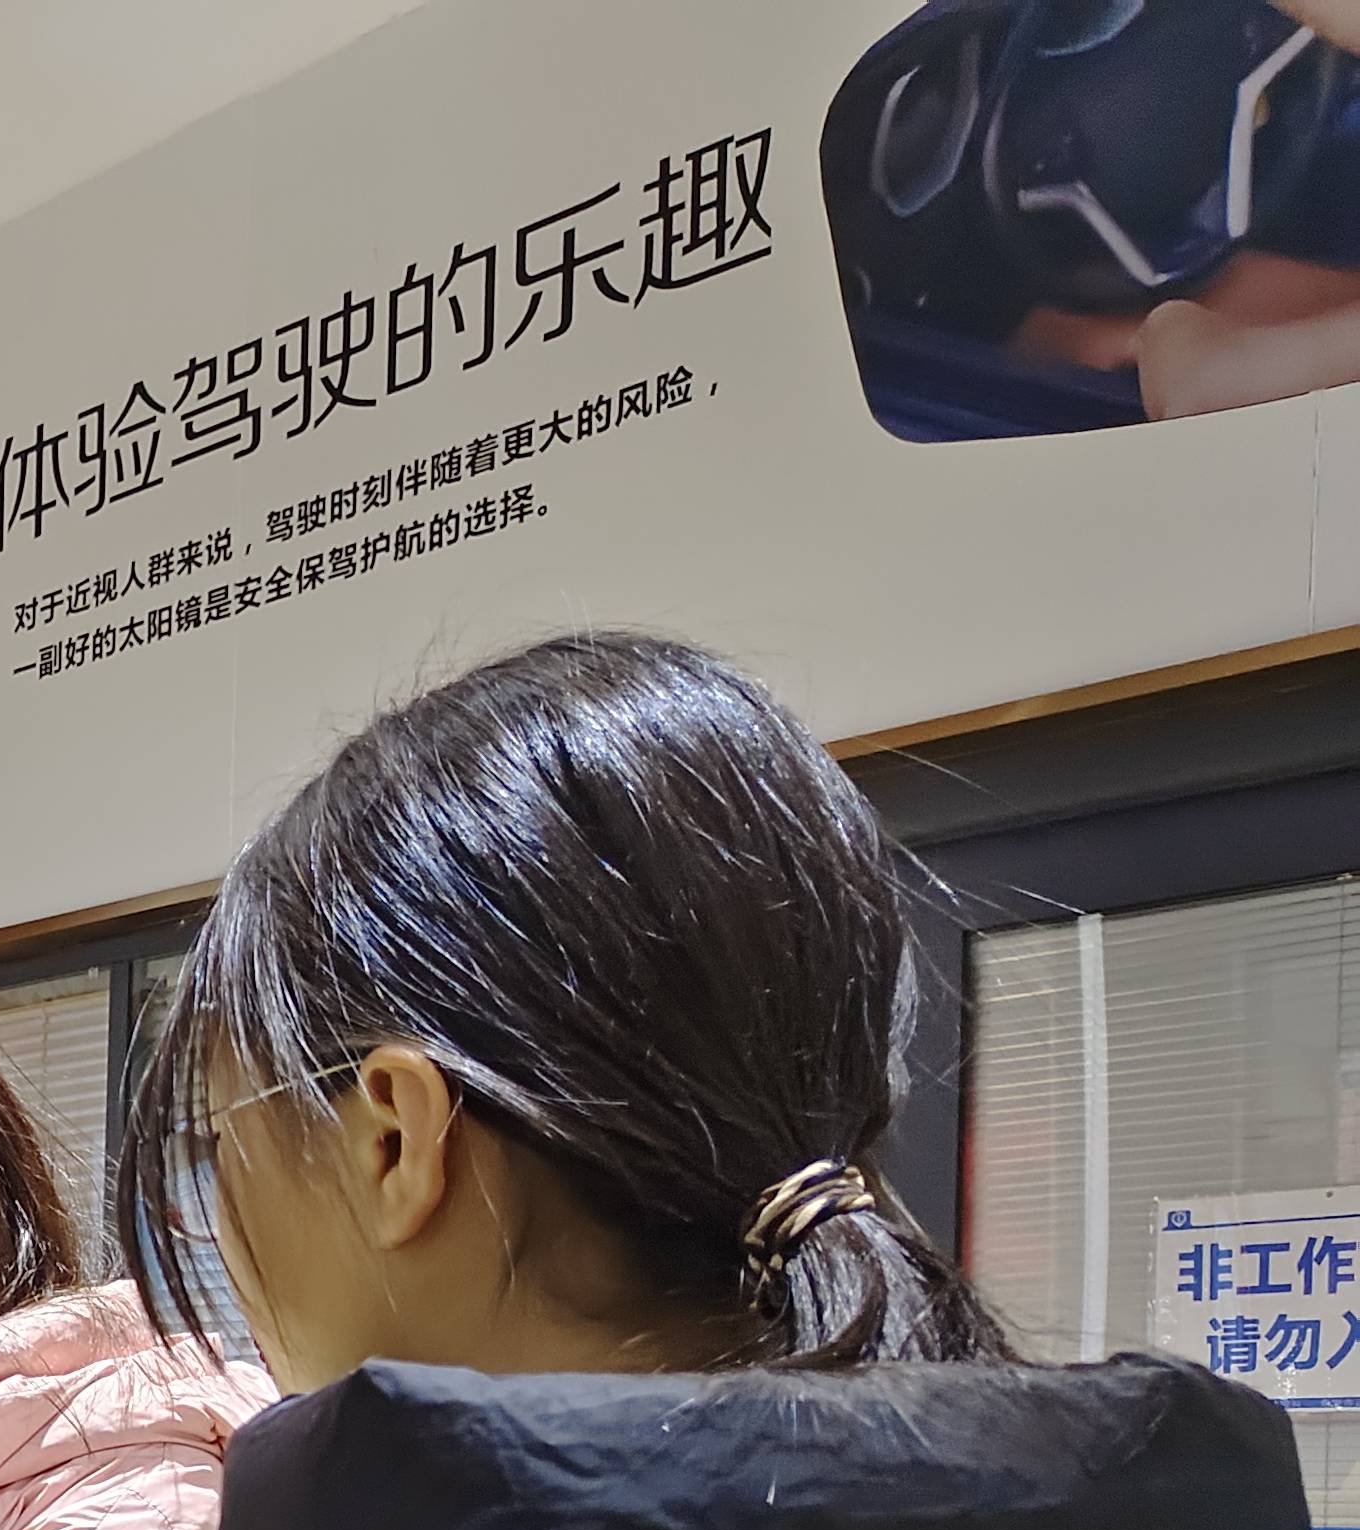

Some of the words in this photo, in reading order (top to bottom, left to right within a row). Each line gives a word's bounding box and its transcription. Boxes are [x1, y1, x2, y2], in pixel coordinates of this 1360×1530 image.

[13, 366, 720, 633] 对于近视人群来说，驾驶时刻伴随着更大的风险，
[13, 483, 549, 679] 一副好的太阳镜是安全保驾护航的选择。
[1177, 1235, 1357, 1301] 非工作
